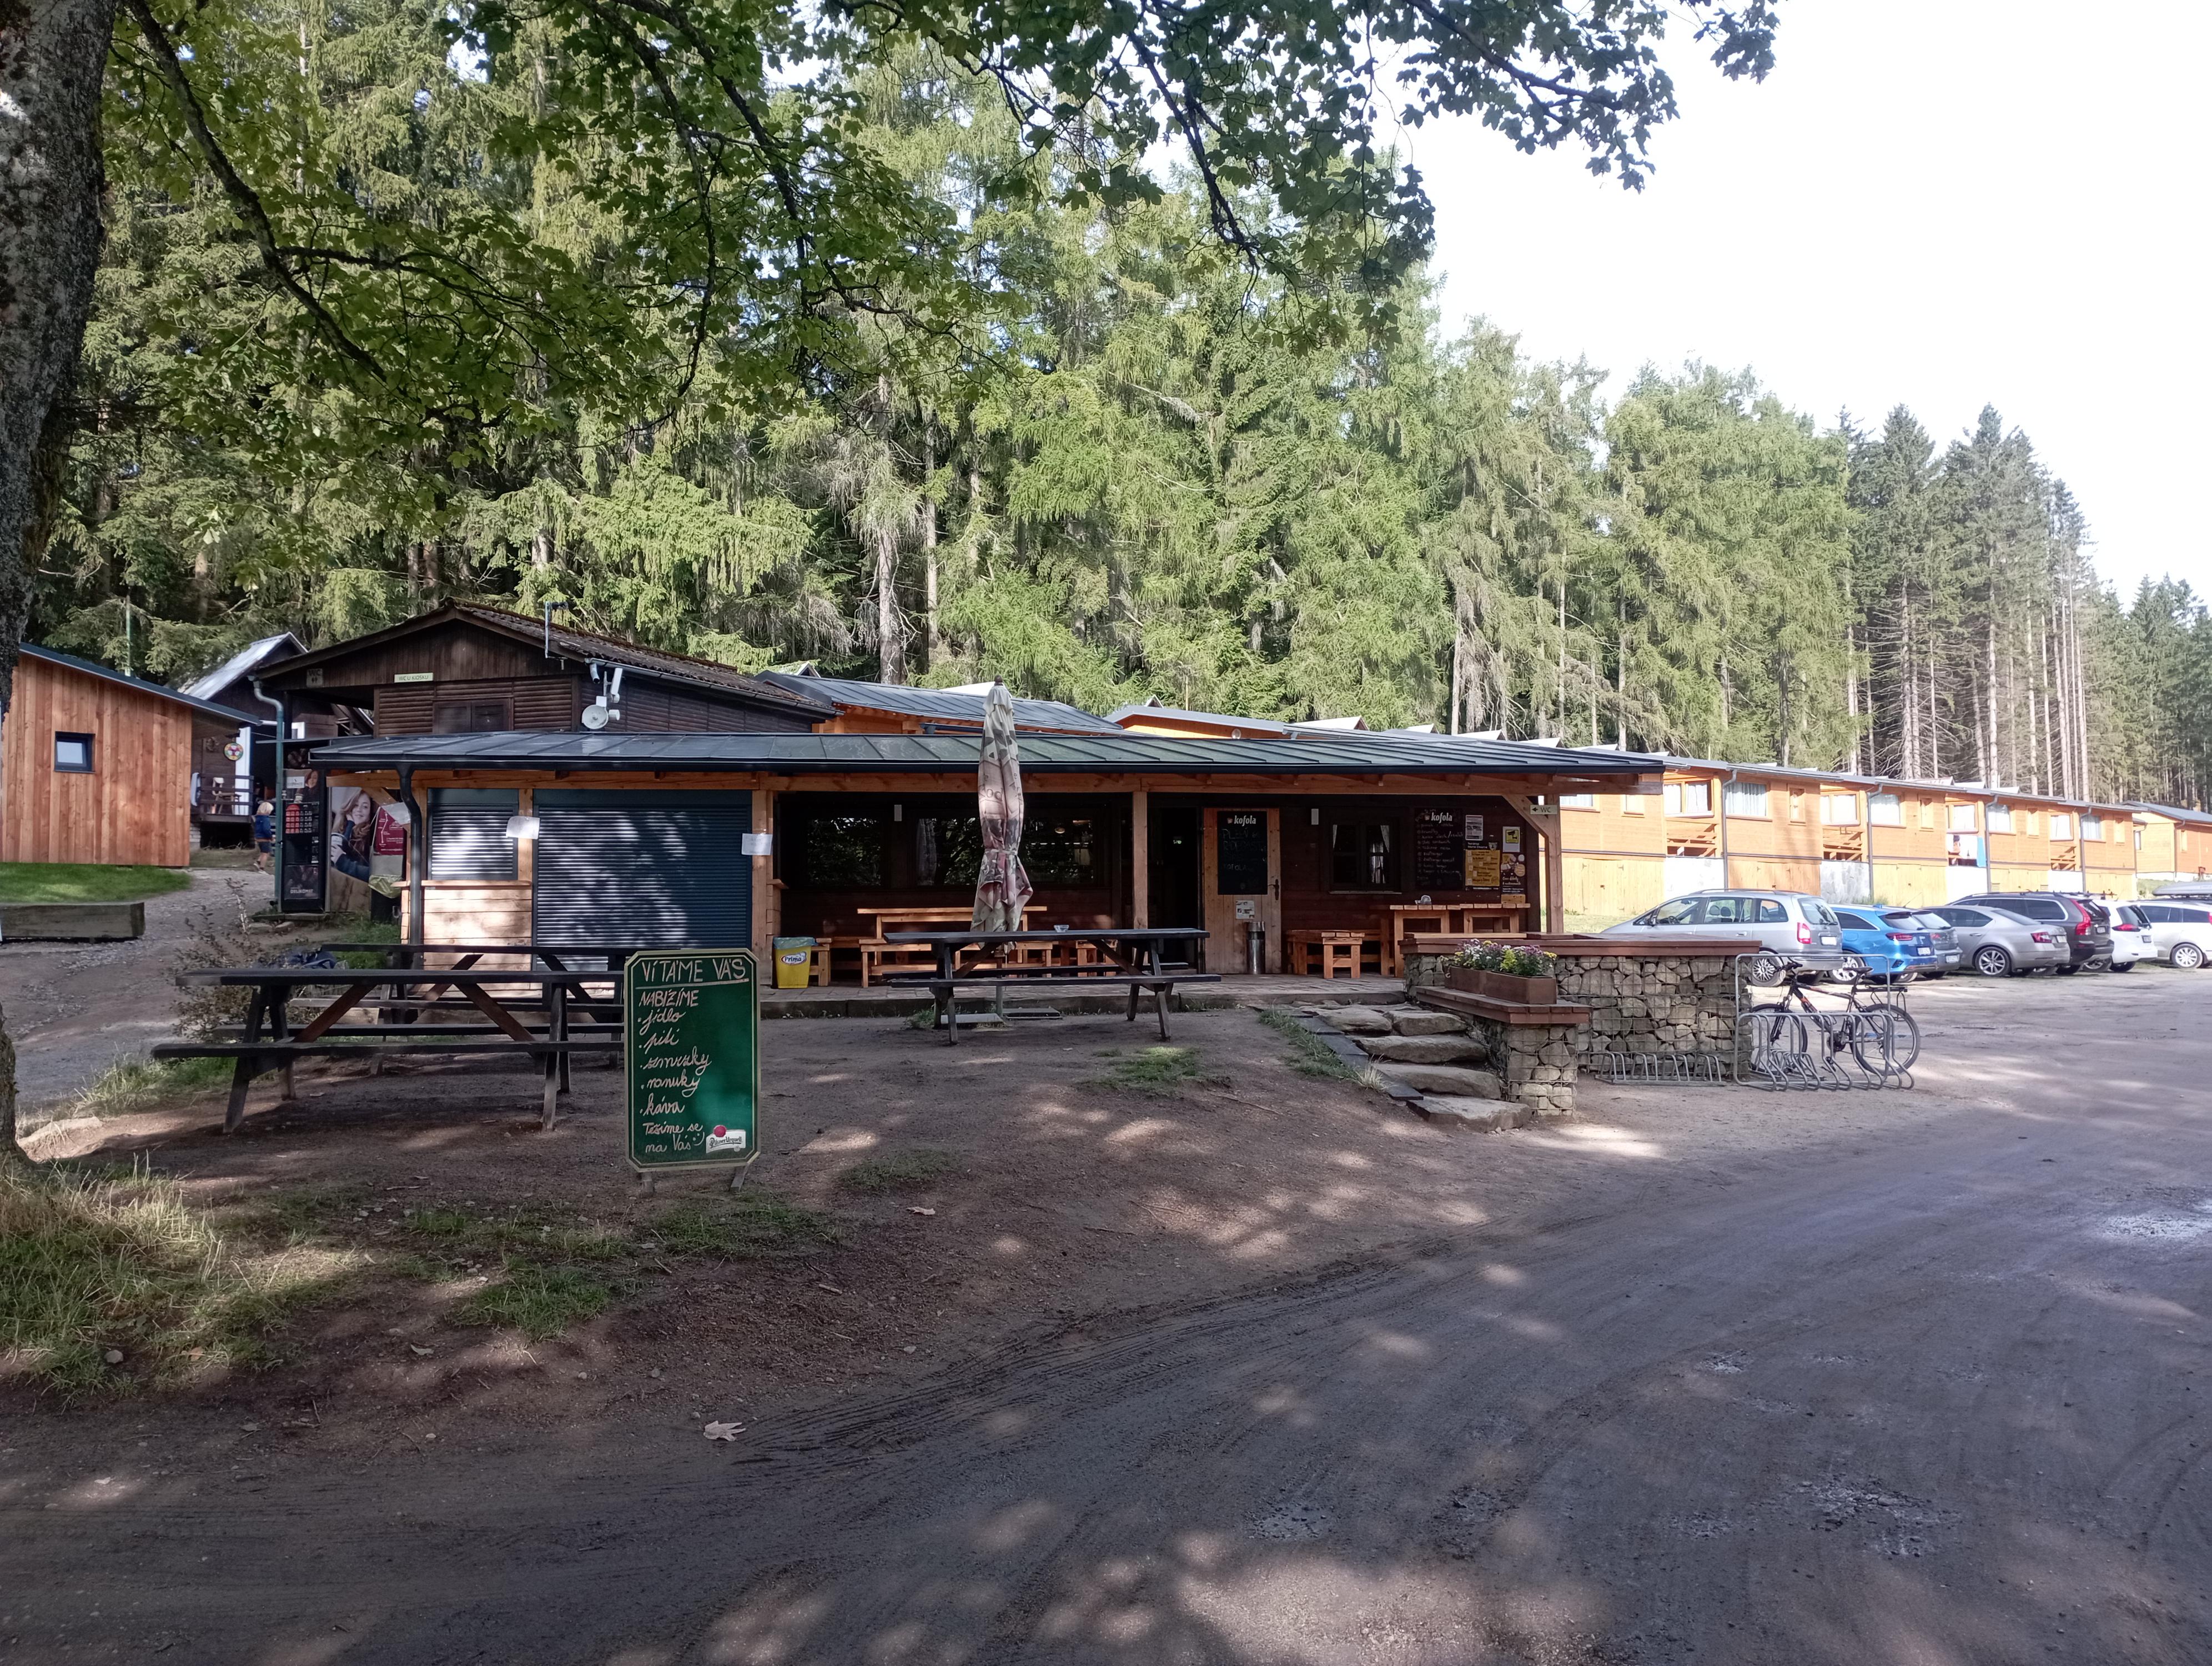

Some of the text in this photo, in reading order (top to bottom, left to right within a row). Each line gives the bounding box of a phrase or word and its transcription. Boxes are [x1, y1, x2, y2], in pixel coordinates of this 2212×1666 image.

[1234, 815, 1256, 827] kofola
[1431, 812, 1452, 824] kofola
[712, 958, 746, 980] VÁS
[639, 987, 700, 1007] NABÍŽÍME
[639, 1008, 686, 1036] jídlo
[642, 1092, 685, 1116] káva
[687, 1123, 703, 1132] se
[645, 1133, 691, 1153] na Vás
[709, 1136, 742, 1149] Pilsner Urquell
